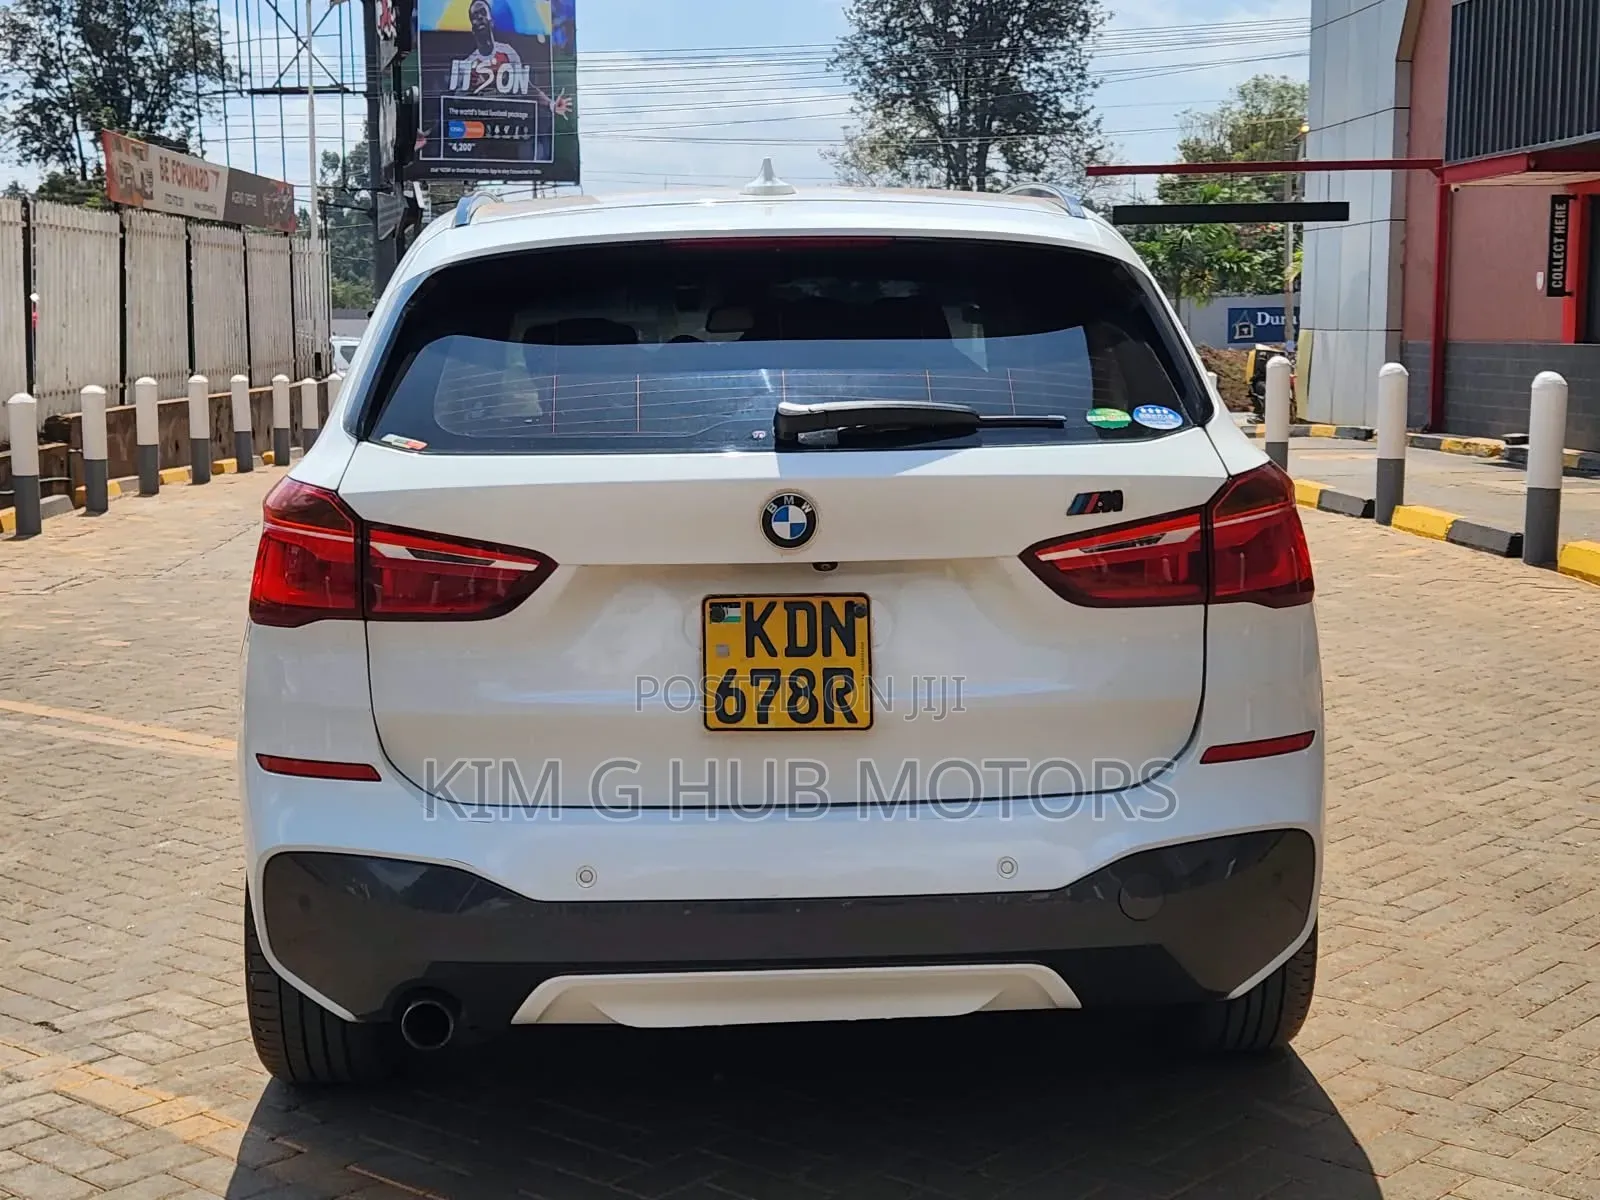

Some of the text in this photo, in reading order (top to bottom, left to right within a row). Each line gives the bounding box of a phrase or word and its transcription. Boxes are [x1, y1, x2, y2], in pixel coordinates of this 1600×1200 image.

[496, 63, 530, 95] ON
[172, 160, 209, 192] FORWARD
[1551, 203, 1567, 289] COLLECT HERE
[766, 495, 812, 514] BMW
[745, 600, 856, 658] KDN
[714, 667, 858, 725] 678R
